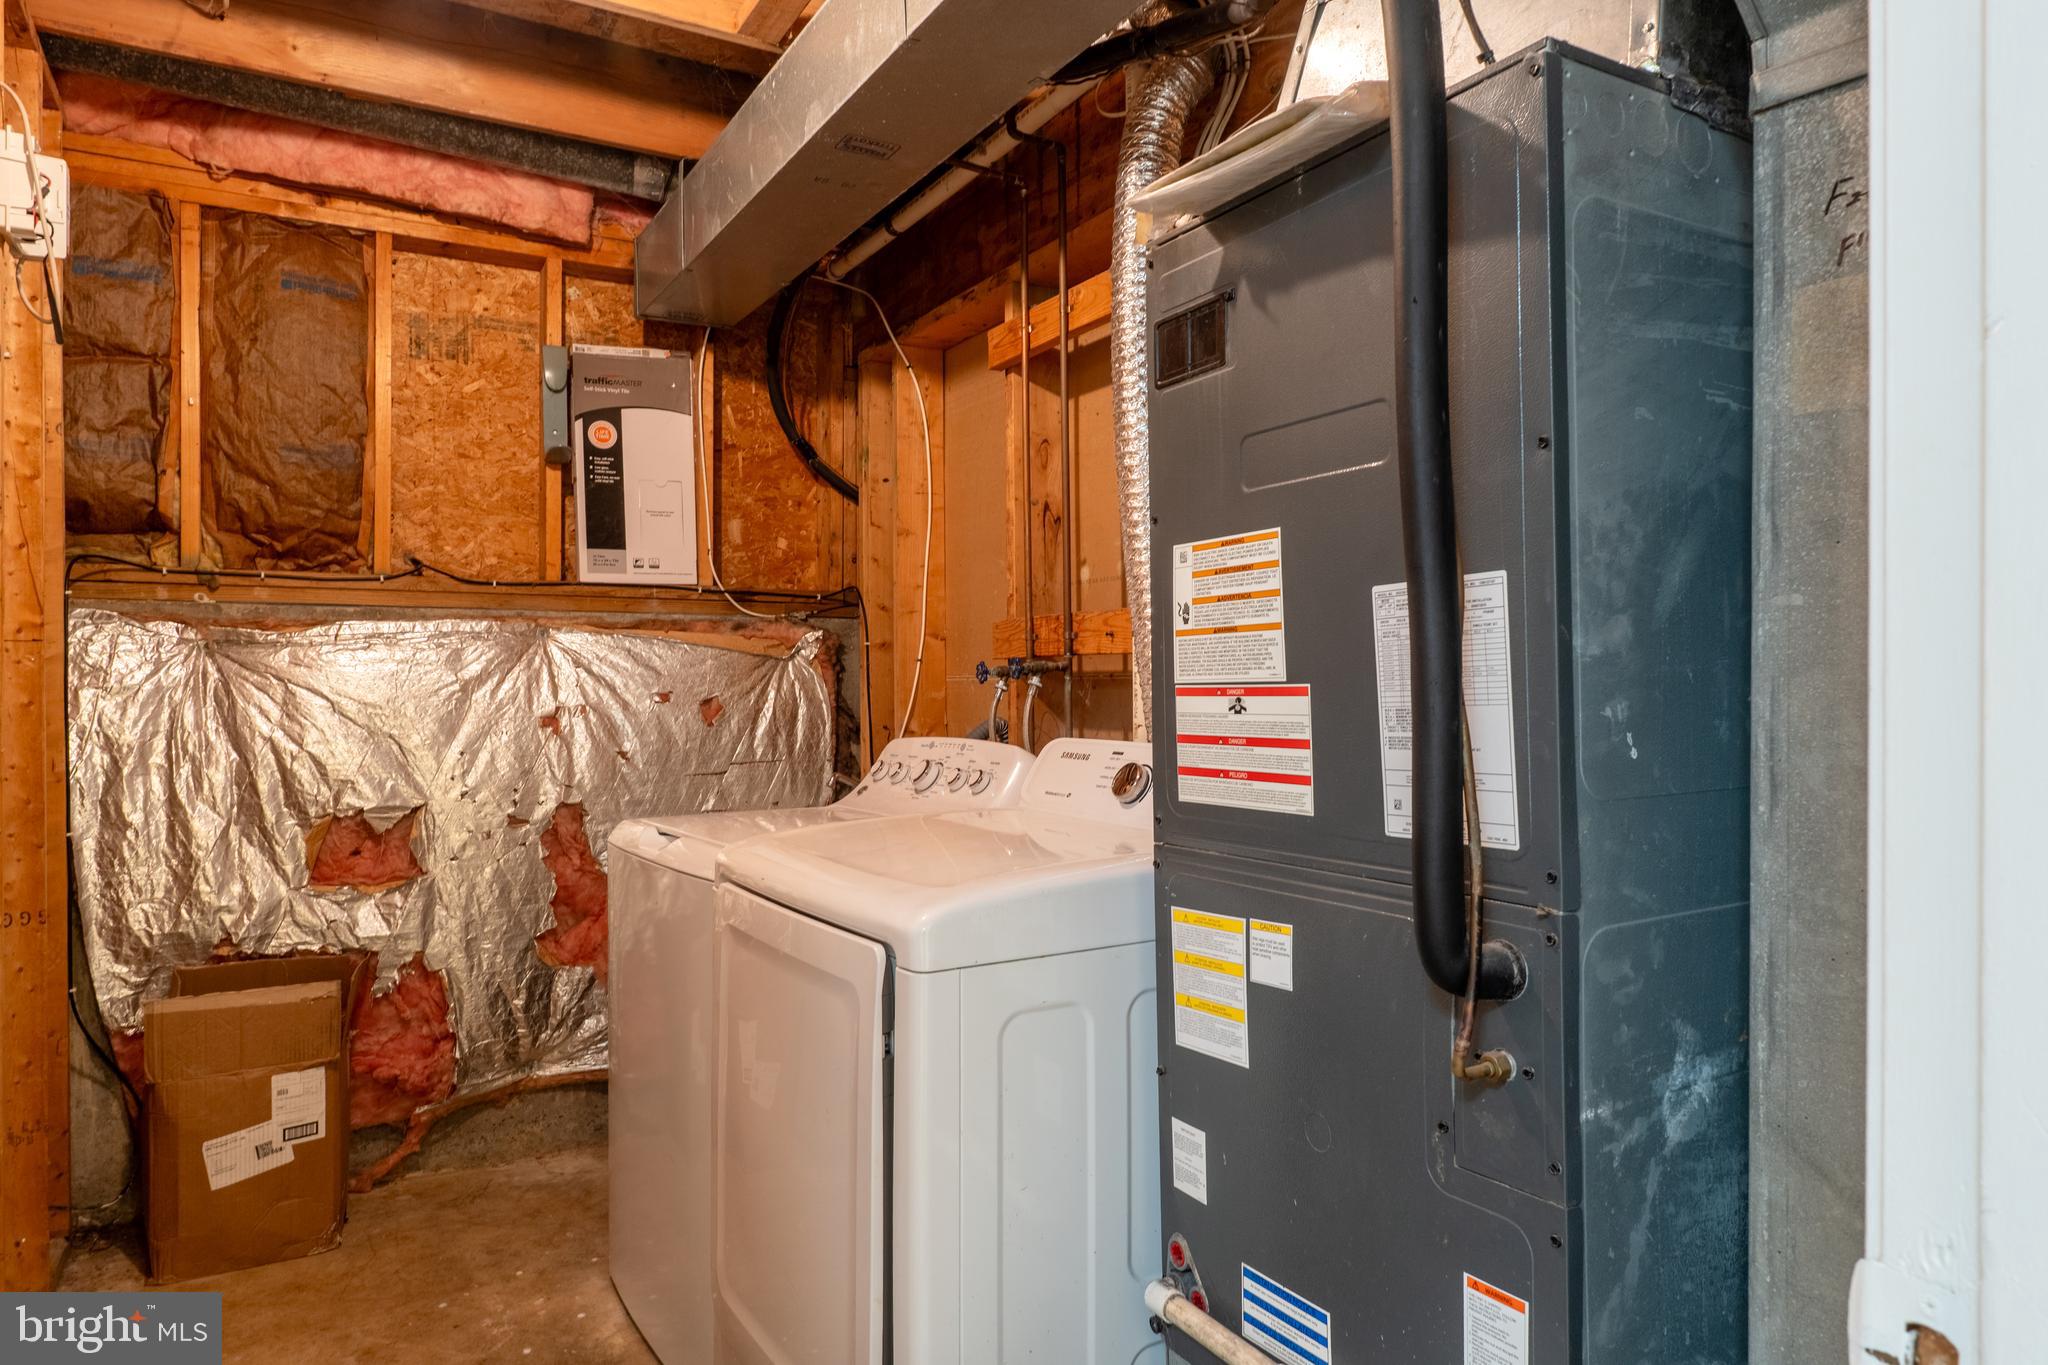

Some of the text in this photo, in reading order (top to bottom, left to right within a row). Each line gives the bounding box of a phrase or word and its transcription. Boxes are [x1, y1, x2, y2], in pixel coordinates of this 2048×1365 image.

[584, 376, 642, 387] trafficMASTER
[1225, 537, 1245, 546] WARNING
[1060, 751, 1091, 761] SAMSUNG
[1259, 923, 1282, 933] CAUTION
[1485, 1287, 1514, 1306] WARNING
